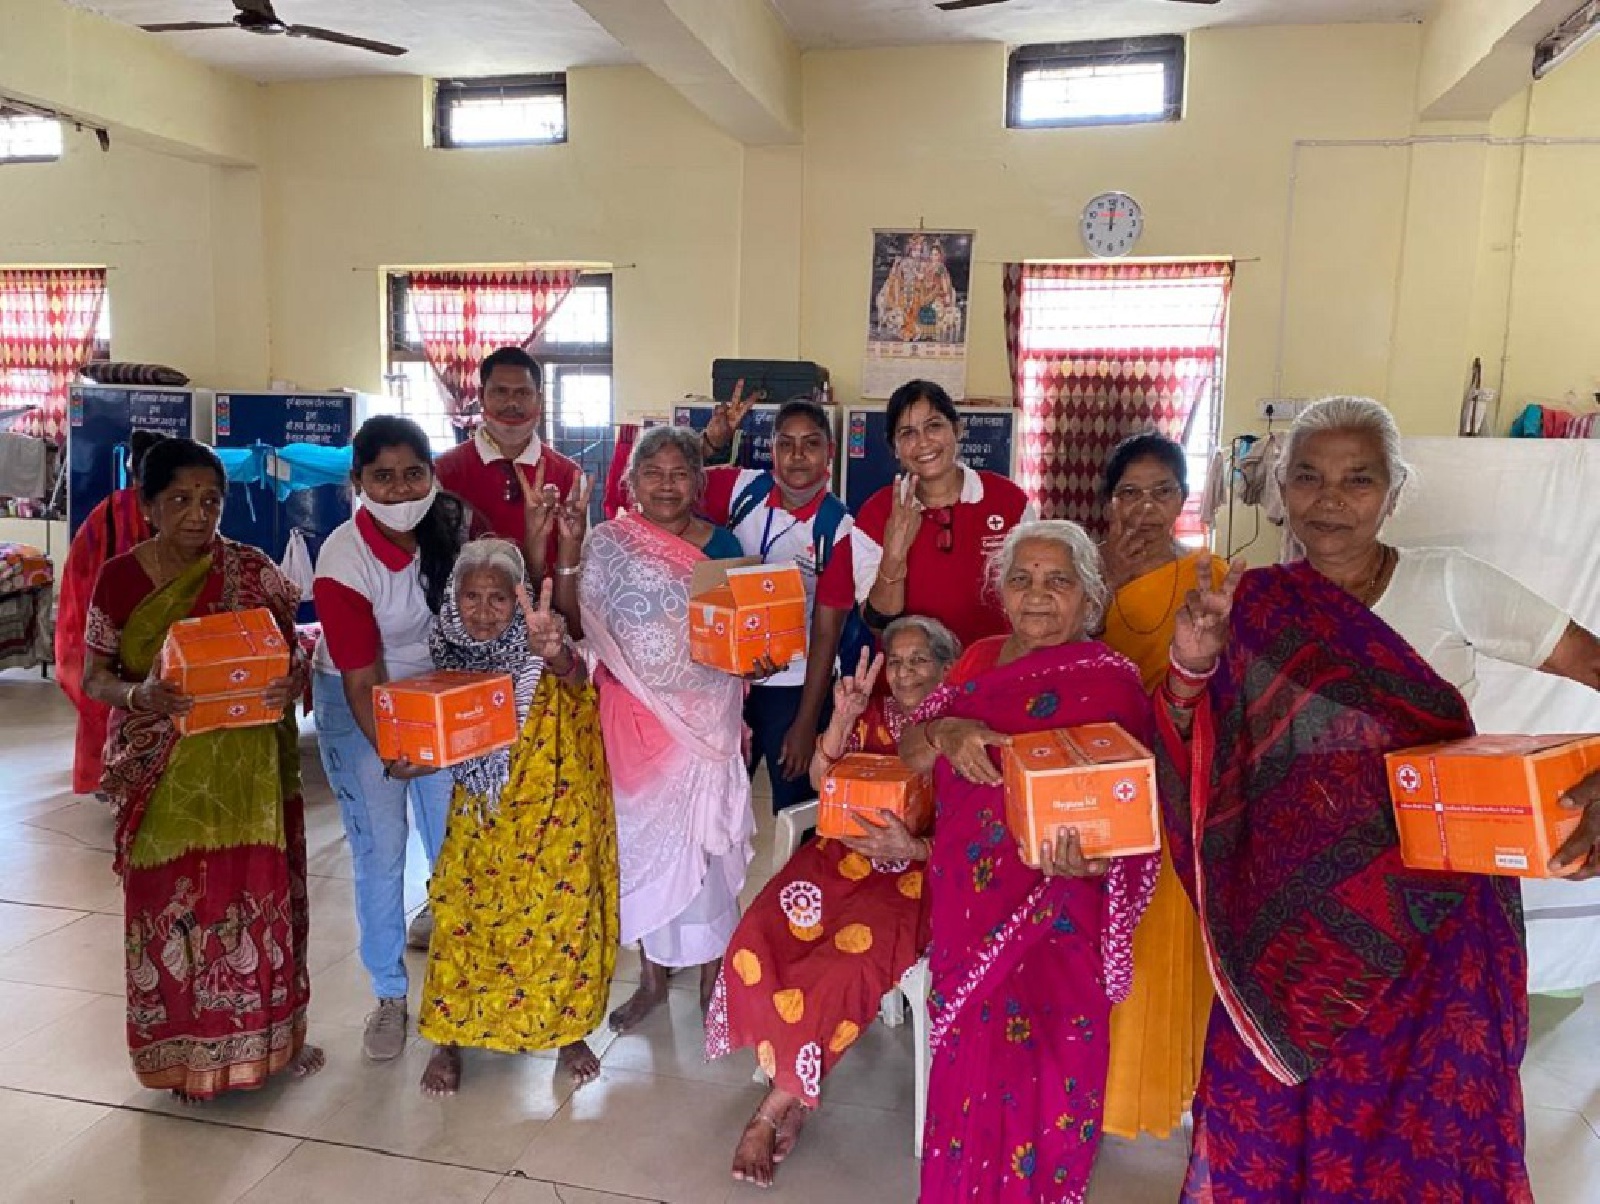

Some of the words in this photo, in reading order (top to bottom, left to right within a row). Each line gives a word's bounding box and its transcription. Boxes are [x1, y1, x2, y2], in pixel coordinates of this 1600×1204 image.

[1089, 210, 1097, 219] 10
[1128, 208, 1134, 216] 2
[1132, 220, 1136, 228] 3
[1107, 242, 1113, 252] 6
